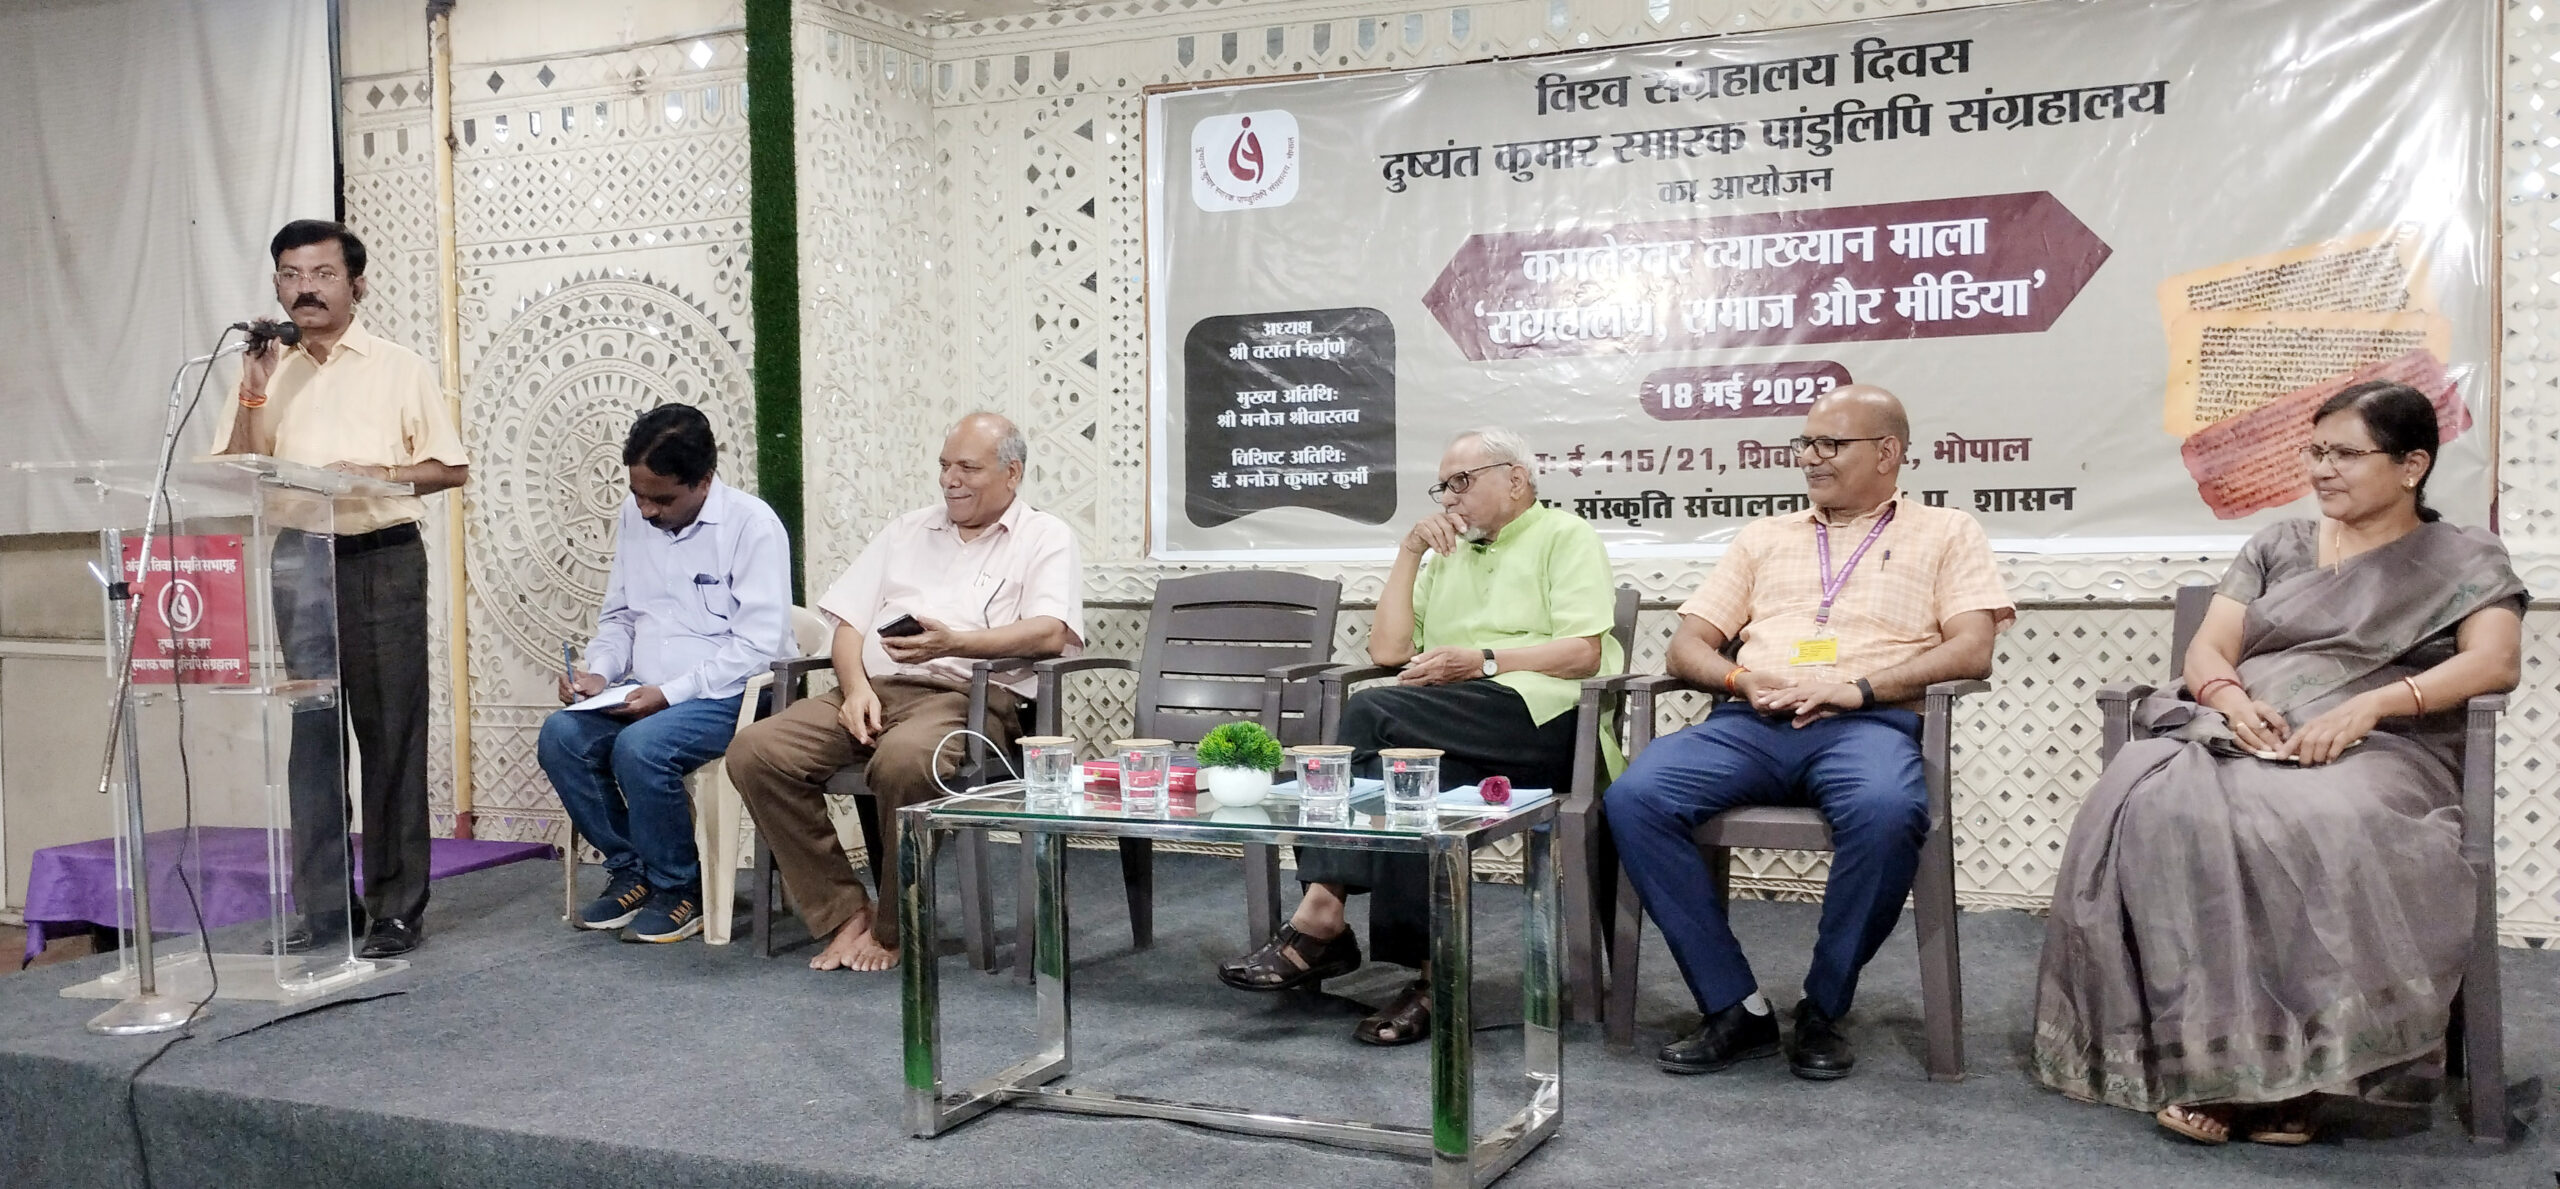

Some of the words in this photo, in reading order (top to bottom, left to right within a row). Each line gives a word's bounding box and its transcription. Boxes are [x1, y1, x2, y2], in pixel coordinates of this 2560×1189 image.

[1536, 72, 1632, 116] विश्व
[1643, 53, 1839, 103] संग्रहालय
[1850, 37, 1974, 84] दिवस
[1380, 139, 1482, 194] दुष्यंत
[1493, 135, 1602, 183] कुमार
[1610, 121, 1748, 164] स्मारक
[1758, 92, 1934, 157] पांडुलिपि
[1946, 80, 2171, 134] संग्रहालय
[1656, 179, 1699, 204] का
[1708, 164, 1835, 200] आयोजन
[1521, 234, 1695, 284] कमलेश्वर
[1700, 226, 1877, 272] व्याख्यान
[1887, 217, 1989, 259] माला
[1683, 294, 1797, 335] समाज
[1807, 277, 1885, 327] और
[1262, 319, 1313, 337] अध्यक्ष
[1229, 341, 1248, 361] श्री
[1252, 341, 1291, 360] वसंत
[1296, 336, 1346, 361] निर्गुणे
[1236, 389, 1278, 409] मुख्य
[1656, 382, 1693, 410] 18
[1702, 372, 1745, 411] मई
[1752, 376, 1837, 406] 2023
[1216, 409, 1237, 428] श्री
[1241, 408, 1285, 427] मनोज
[1289, 407, 1360, 427] श्रीवास्तव
[1231, 446, 1285, 467] विशिष्ट
[1567, 444, 1585, 478] ई
[1600, 444, 1726, 476] 115/21,
[1934, 432, 2032, 463] भोपाल
[1211, 471, 1231, 489] डॉ.
[1235, 469, 1279, 488] मनोज
[1283, 472, 1328, 490] कुमार
[1332, 466, 1369, 490] कुर्मी
[1574, 490, 1675, 527] संस्कृति
[1683, 487, 1810, 519] संचालना
[1973, 486, 2078, 513] शासन
[179, 555, 203, 575] स्मृति
[203, 559, 237, 574] सभागृह
[187, 638, 213, 653] कुमार
[202, 656, 240, 672] संग्रहालय
